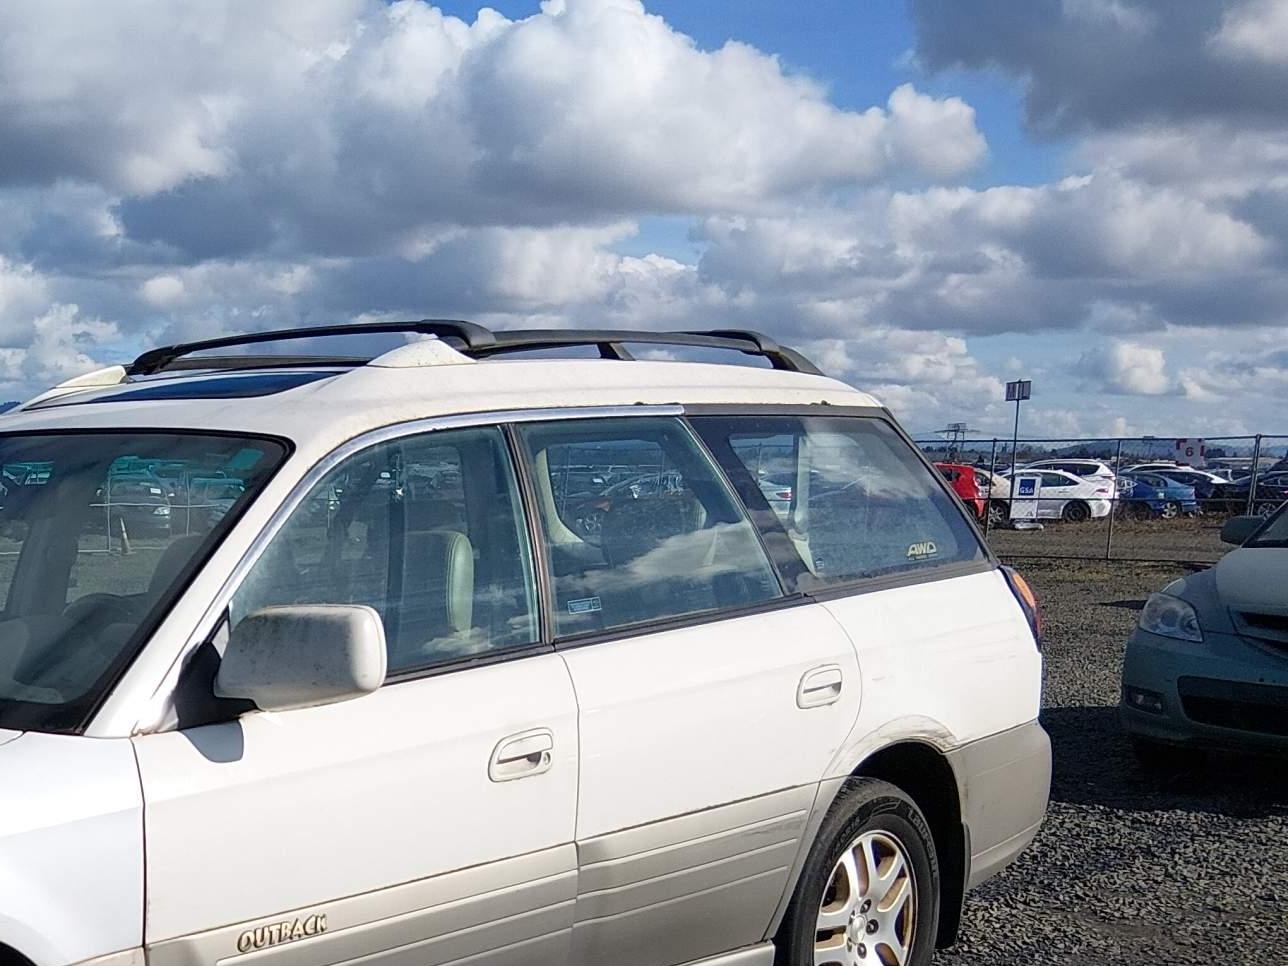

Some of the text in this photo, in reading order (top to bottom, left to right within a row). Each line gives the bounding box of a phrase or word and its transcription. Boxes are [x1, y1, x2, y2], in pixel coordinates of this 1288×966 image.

[1185, 446, 1194, 457] 6
[905, 541, 937, 557] AWD
[237, 914, 328, 952] OUTBACK
